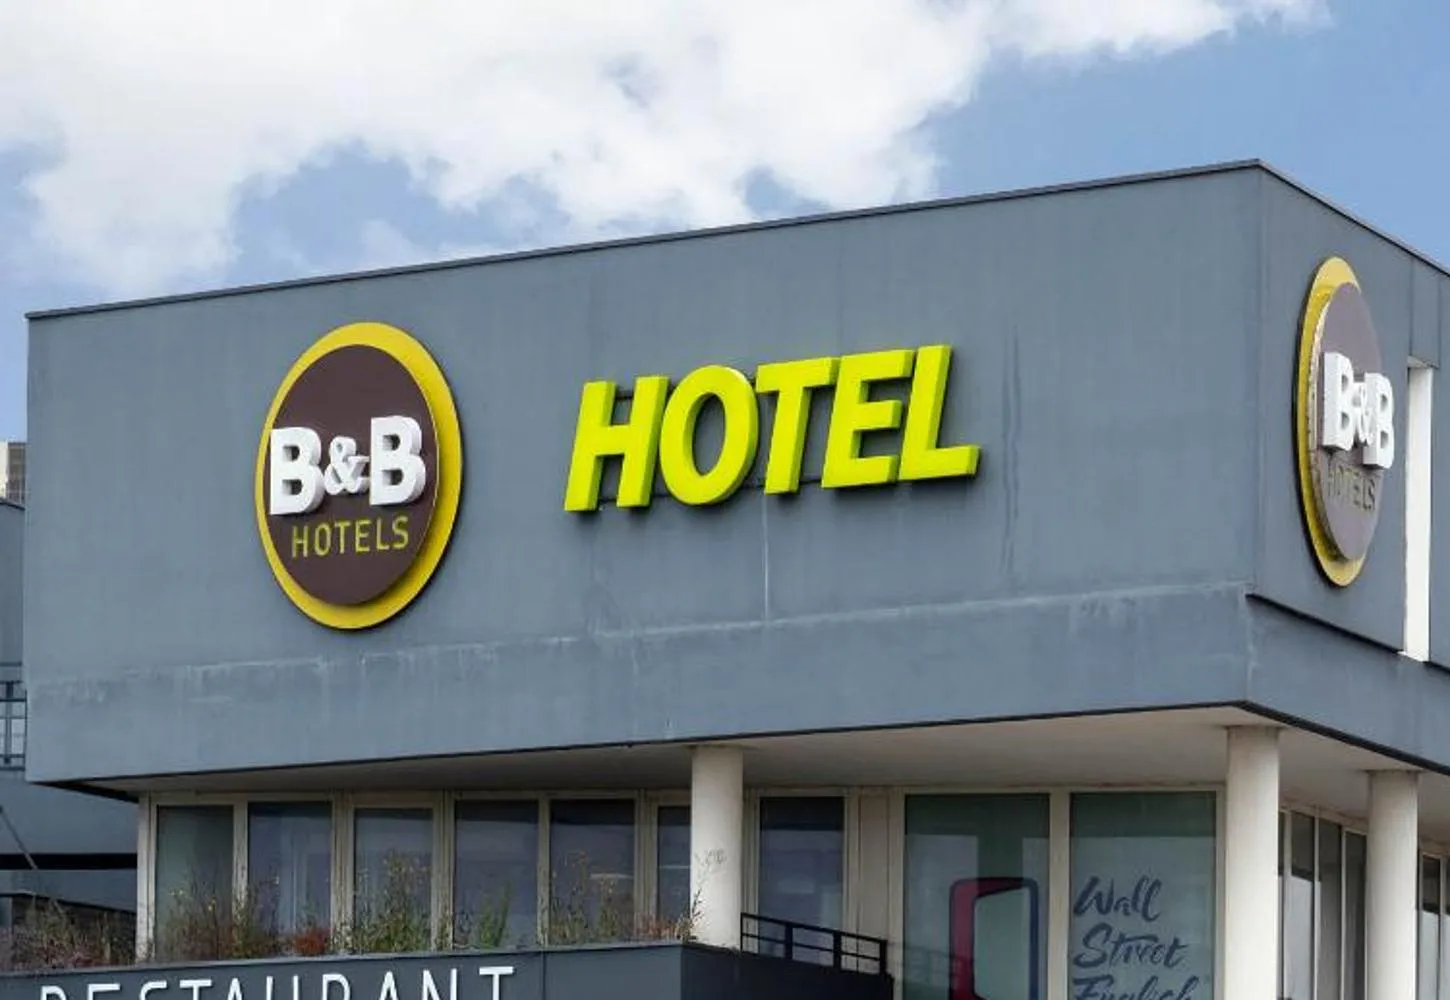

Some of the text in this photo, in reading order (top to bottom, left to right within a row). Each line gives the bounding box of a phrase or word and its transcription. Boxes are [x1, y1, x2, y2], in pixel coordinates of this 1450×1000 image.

[564, 345, 981, 513] HOTEL
[1321, 351, 1394, 470] B&B
[268, 414, 427, 515] B&B
[1326, 458, 1376, 511] HOTELS
[290, 514, 410, 559] HOTELS
[1072, 875, 1162, 922] Wall
[1072, 922, 1188, 969] Street
